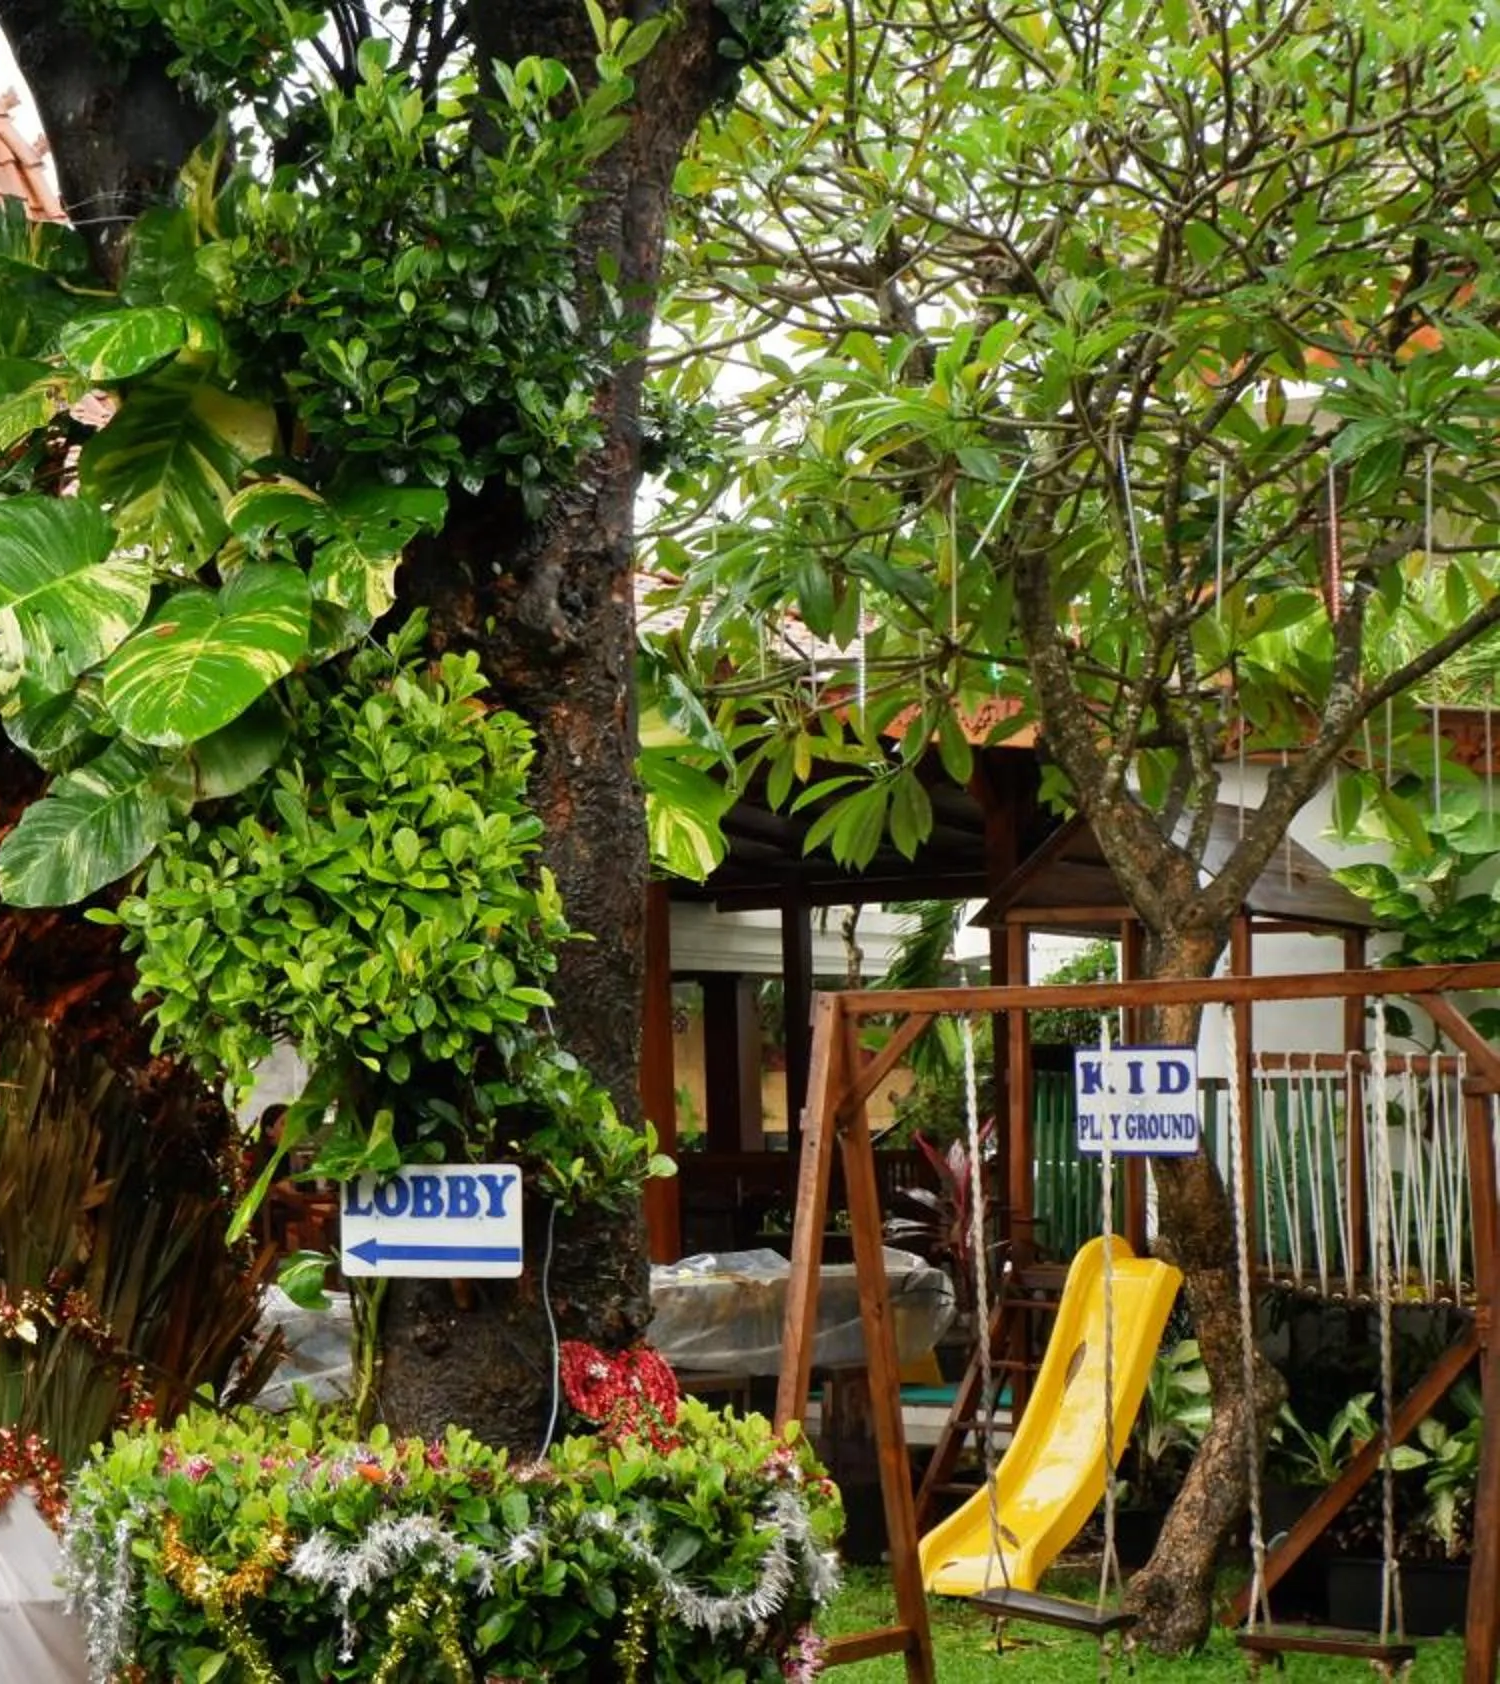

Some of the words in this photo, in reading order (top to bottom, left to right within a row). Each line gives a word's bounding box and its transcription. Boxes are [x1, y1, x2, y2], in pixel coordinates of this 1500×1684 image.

[1080, 1061, 1190, 1093] KID
[1079, 1114, 1121, 1140] PLY
[1126, 1113, 1195, 1140] GROUND
[344, 1174, 516, 1217] LOBBY
